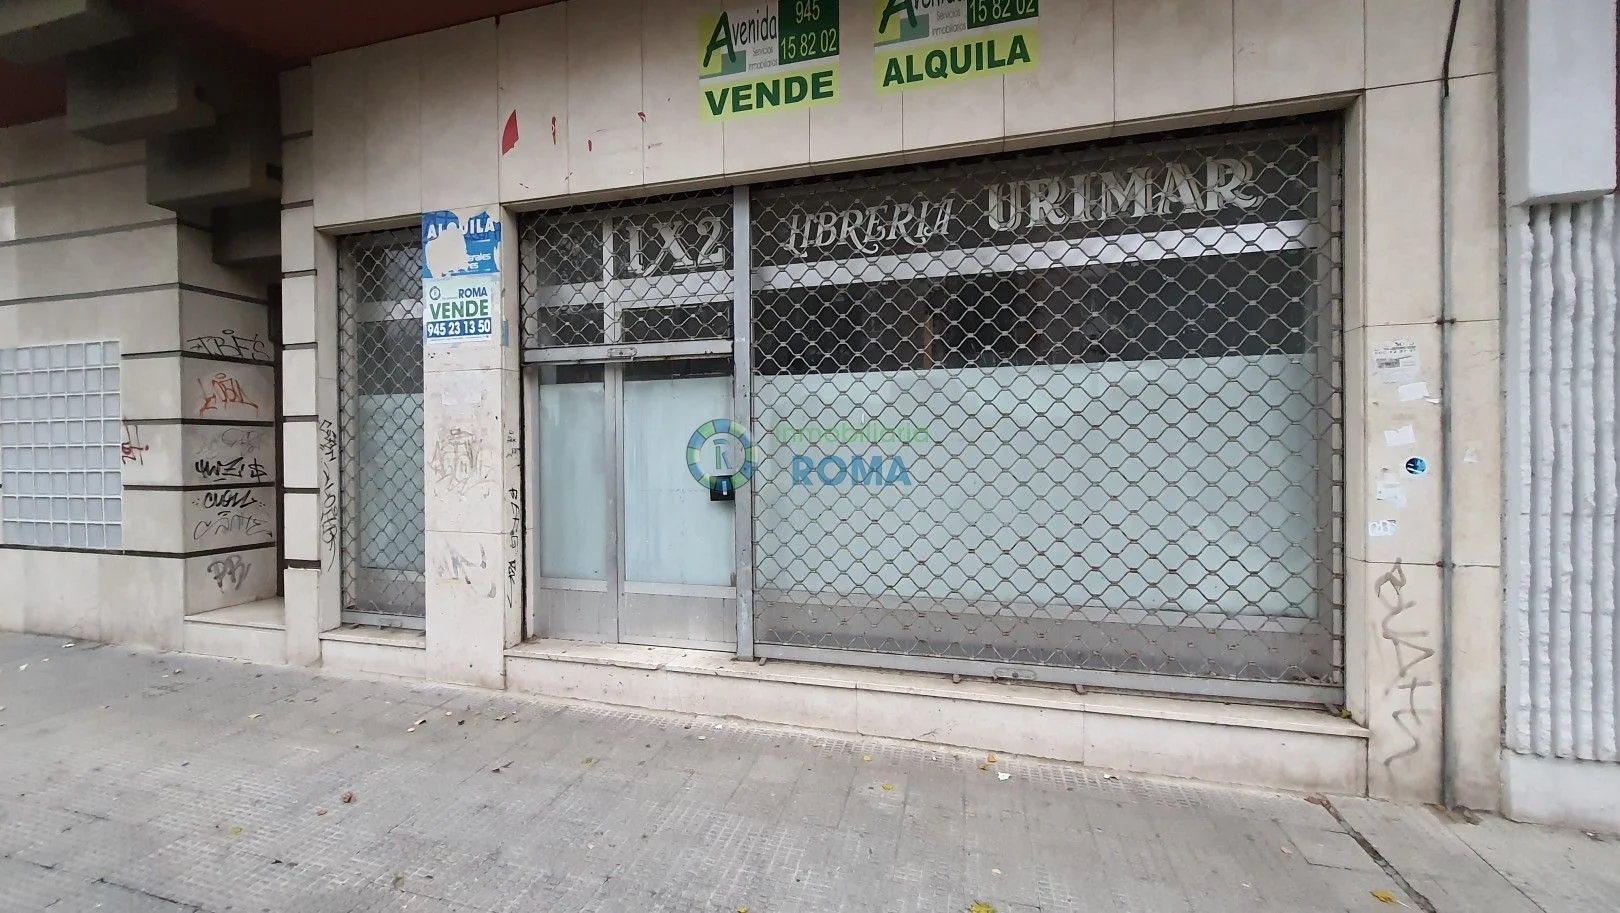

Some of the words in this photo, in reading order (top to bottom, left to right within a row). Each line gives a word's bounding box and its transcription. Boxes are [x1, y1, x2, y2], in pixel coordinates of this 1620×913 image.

[795, 0, 820, 24] 945
[969, 0, 988, 23] 15
[992, 0, 1012, 19] 82
[703, 4, 778, 68] Avenida
[781, 35, 796, 60] 15
[800, 31, 817, 57] 82
[820, 28, 837, 53] 02
[882, 34, 1031, 88] ALQUILA
[704, 70, 834, 116] VENDE
[783, 199, 955, 258] LIBRERIA
[988, 157, 1264, 232] URIMAR
[458, 286, 488, 299] ROMA
[429, 299, 489, 320] VENDE
[427, 322, 446, 337] 945
[448, 321, 461, 336] 23
[463, 319, 475, 334] 13
[477, 319, 491, 333] 50
